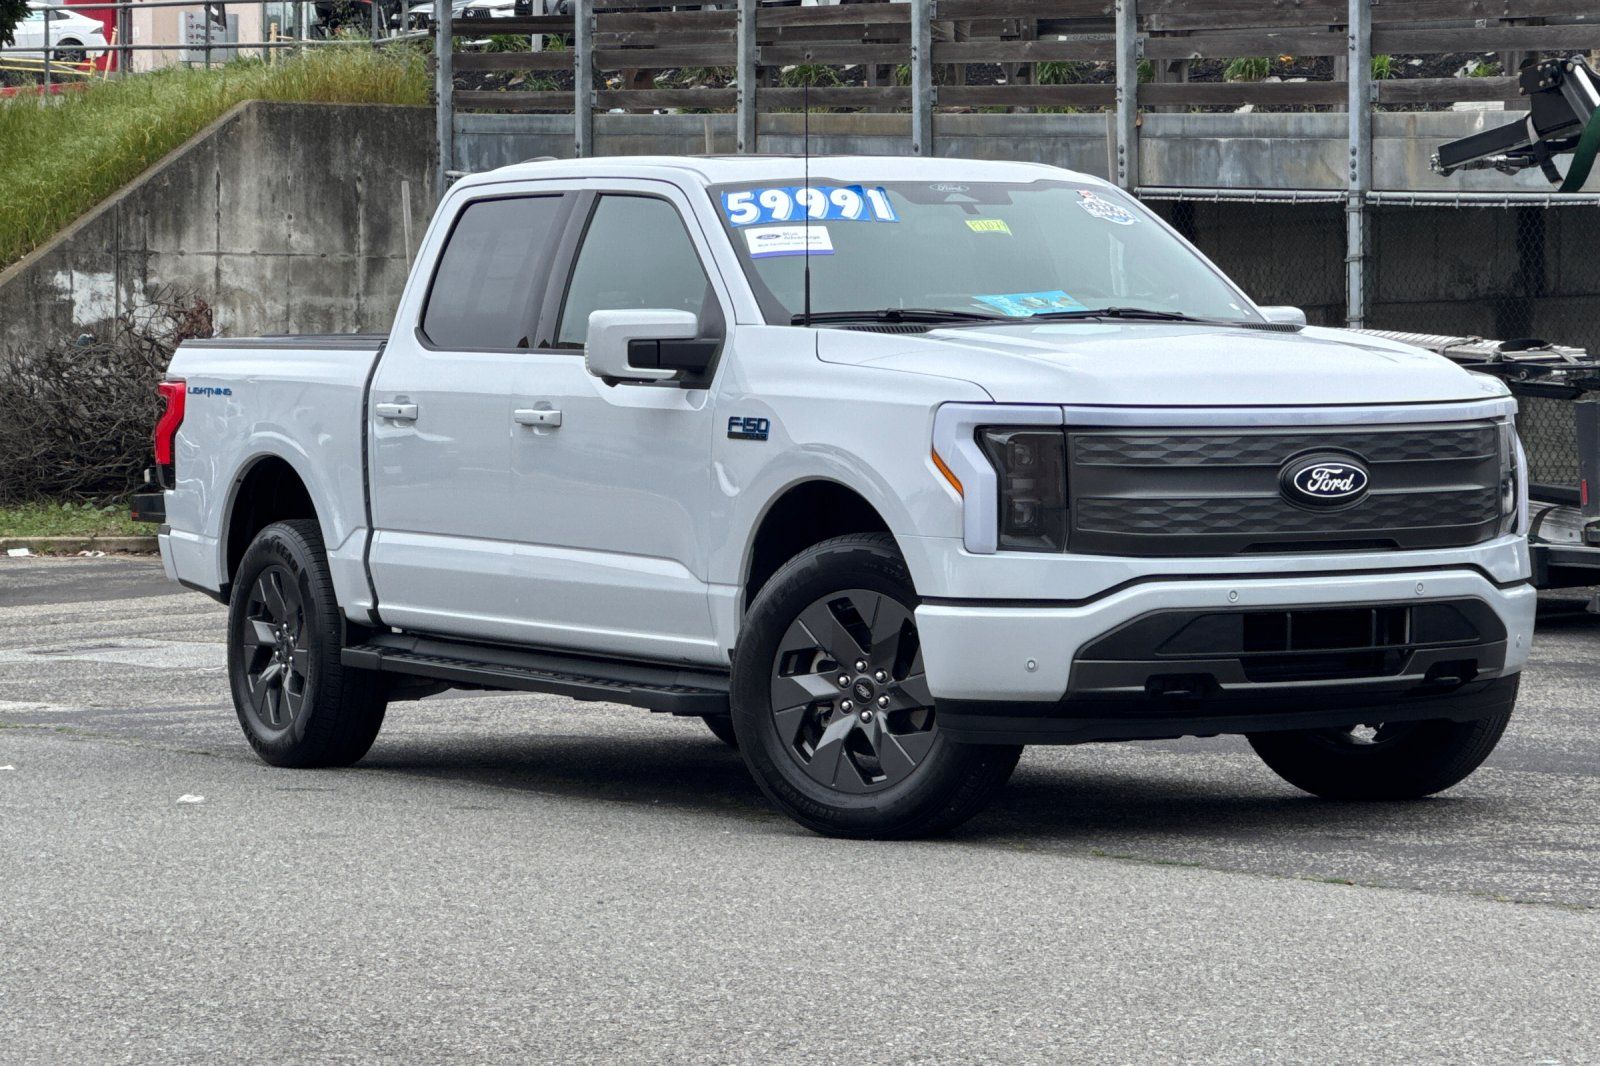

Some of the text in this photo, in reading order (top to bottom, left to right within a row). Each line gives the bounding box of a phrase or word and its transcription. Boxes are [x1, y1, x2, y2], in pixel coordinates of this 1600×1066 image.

[195, 23, 224, 32] Paing
[727, 188, 895, 224] 59991
[1307, 467, 1354, 491] Ford
